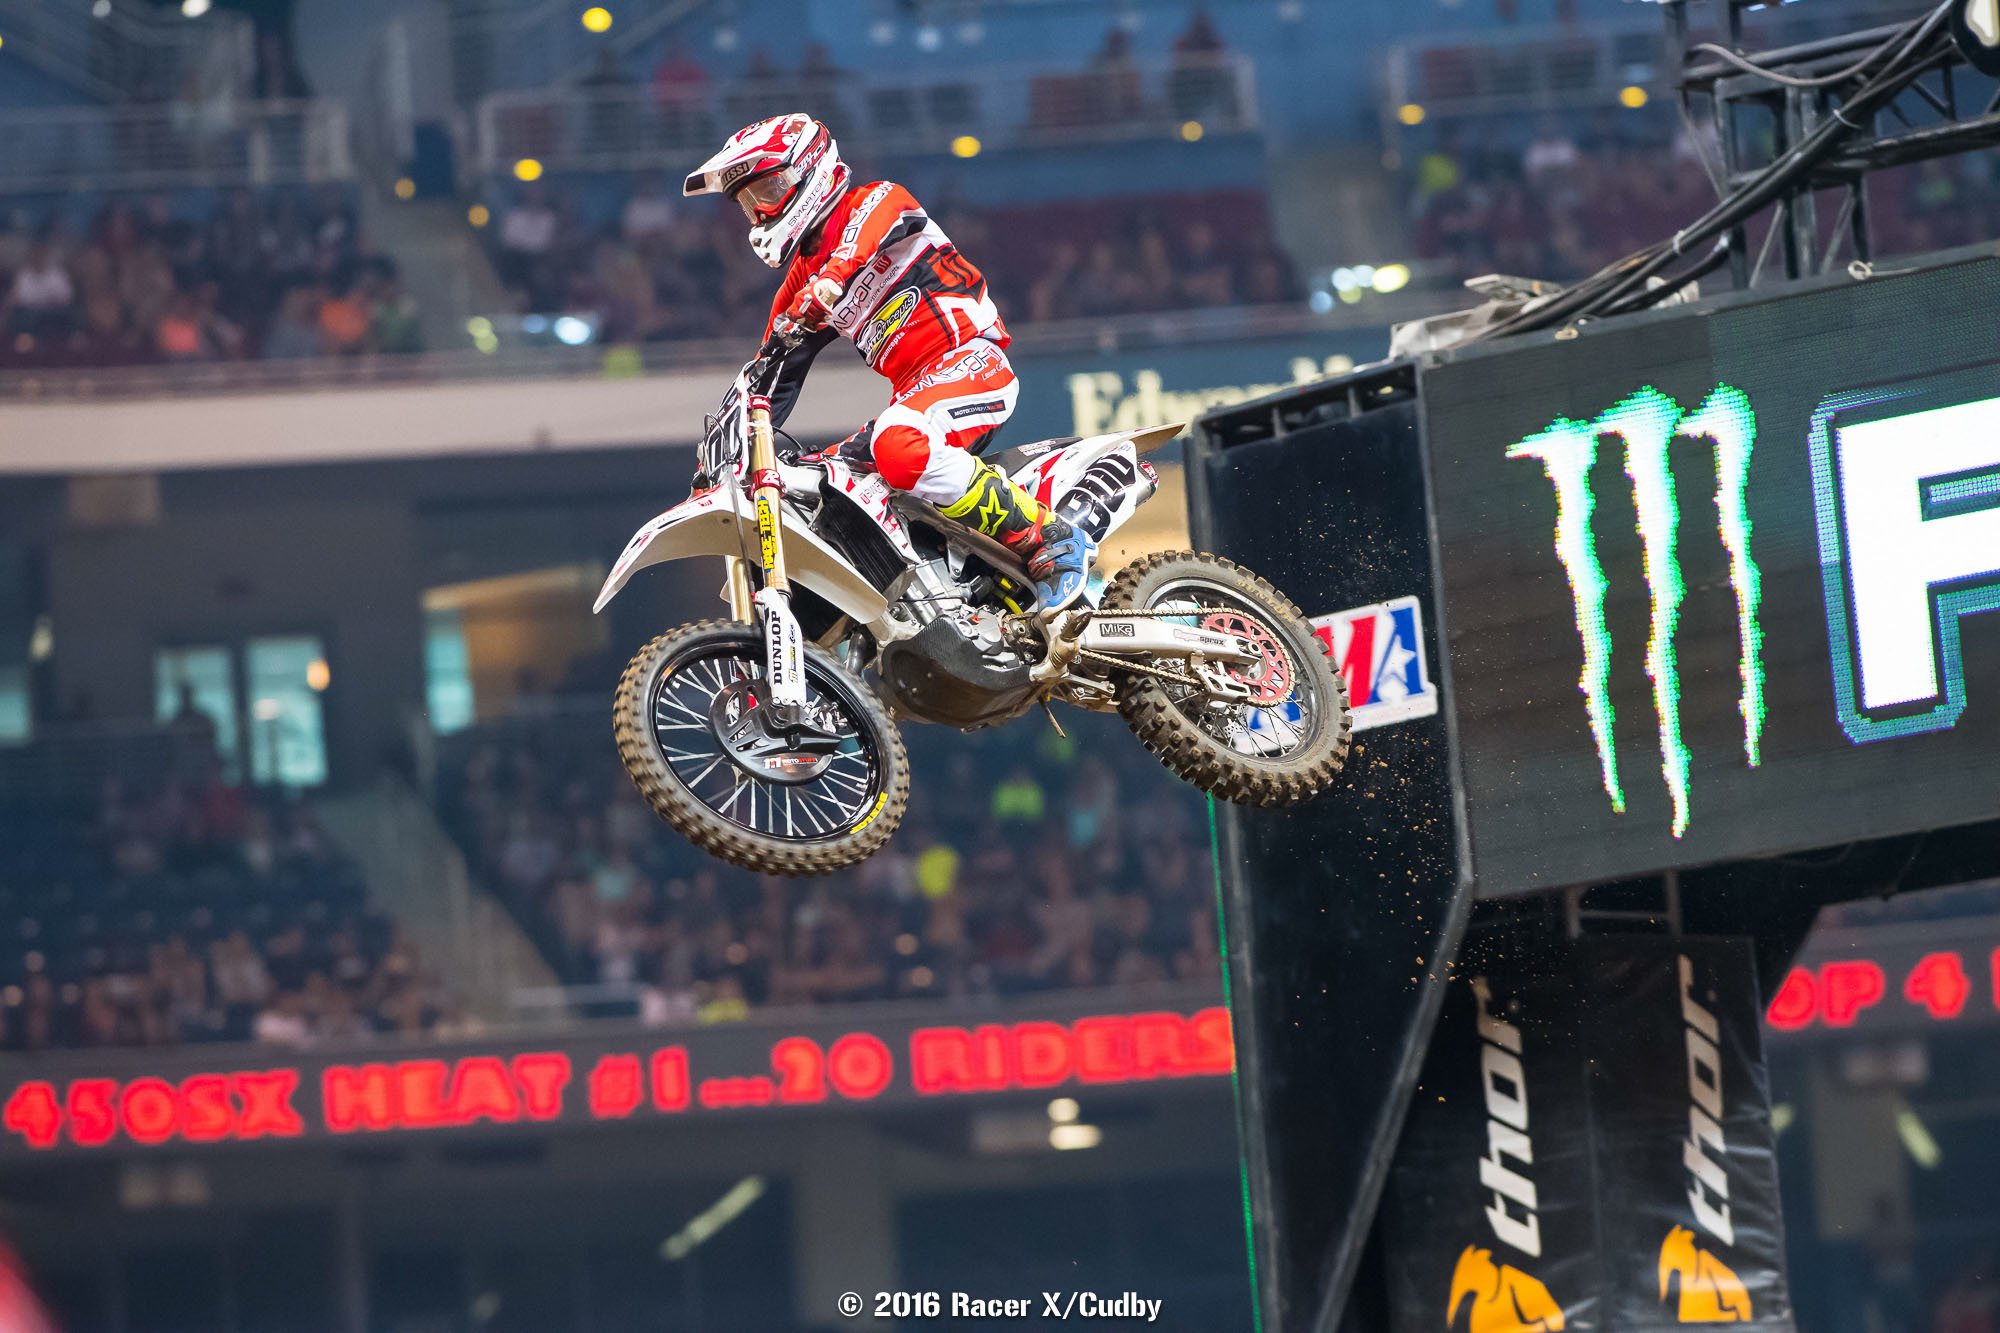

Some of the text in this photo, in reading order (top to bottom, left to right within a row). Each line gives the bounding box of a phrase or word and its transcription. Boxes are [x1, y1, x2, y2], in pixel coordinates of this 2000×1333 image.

[788, 177, 825, 226] SMARTOP
[878, 264, 901, 289] Concepts
[757, 499, 772, 532] TECH
[760, 537, 775, 570] RACE
[771, 611, 782, 685] DUNLOP
[1101, 624, 1133, 636] Mika
[1904, 951, 1972, 1019] 4
[5, 1068, 304, 1149] 450SX
[322, 1052, 570, 1134] HEAT
[910, 1006, 1236, 1096] RIDERS
[1678, 954, 1735, 1247] thor
